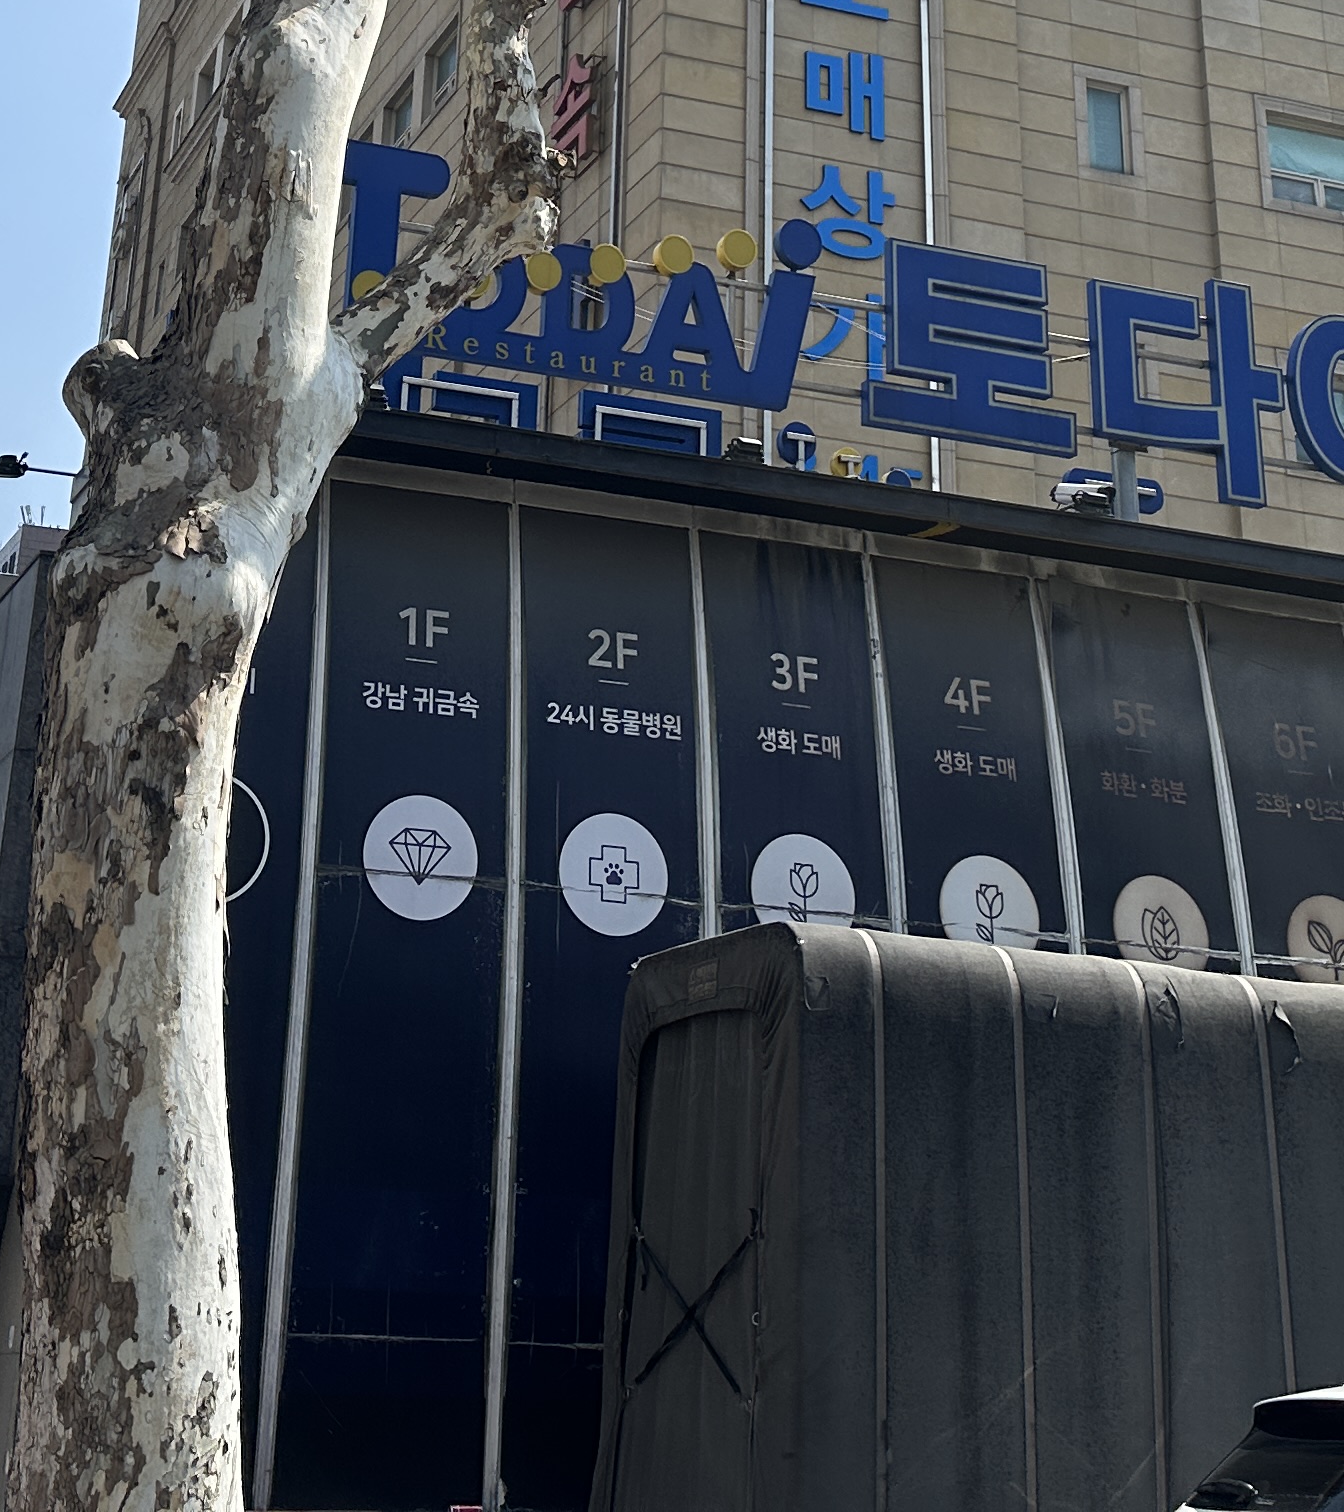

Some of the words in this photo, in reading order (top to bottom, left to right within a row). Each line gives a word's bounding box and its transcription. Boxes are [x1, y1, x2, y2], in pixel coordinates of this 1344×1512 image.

[426, 326, 713, 392] Restaurant
[398, 606, 450, 650] 1F
[587, 628, 639, 671] 2F
[770, 651, 819, 695] 3F
[362, 680, 406, 715] 강남
[413, 683, 480, 721] 귀금속
[943, 675, 992, 717] 4F
[546, 701, 595, 733] 24시
[599, 706, 683, 743] 동물병원
[1112, 698, 1158, 740] 5F
[756, 726, 799, 757] 생화
[802, 730, 842, 762] 도매
[1273, 721, 1319, 762] 6F
[934, 748, 975, 779] 생화
[978, 752, 1018, 783] 도매
